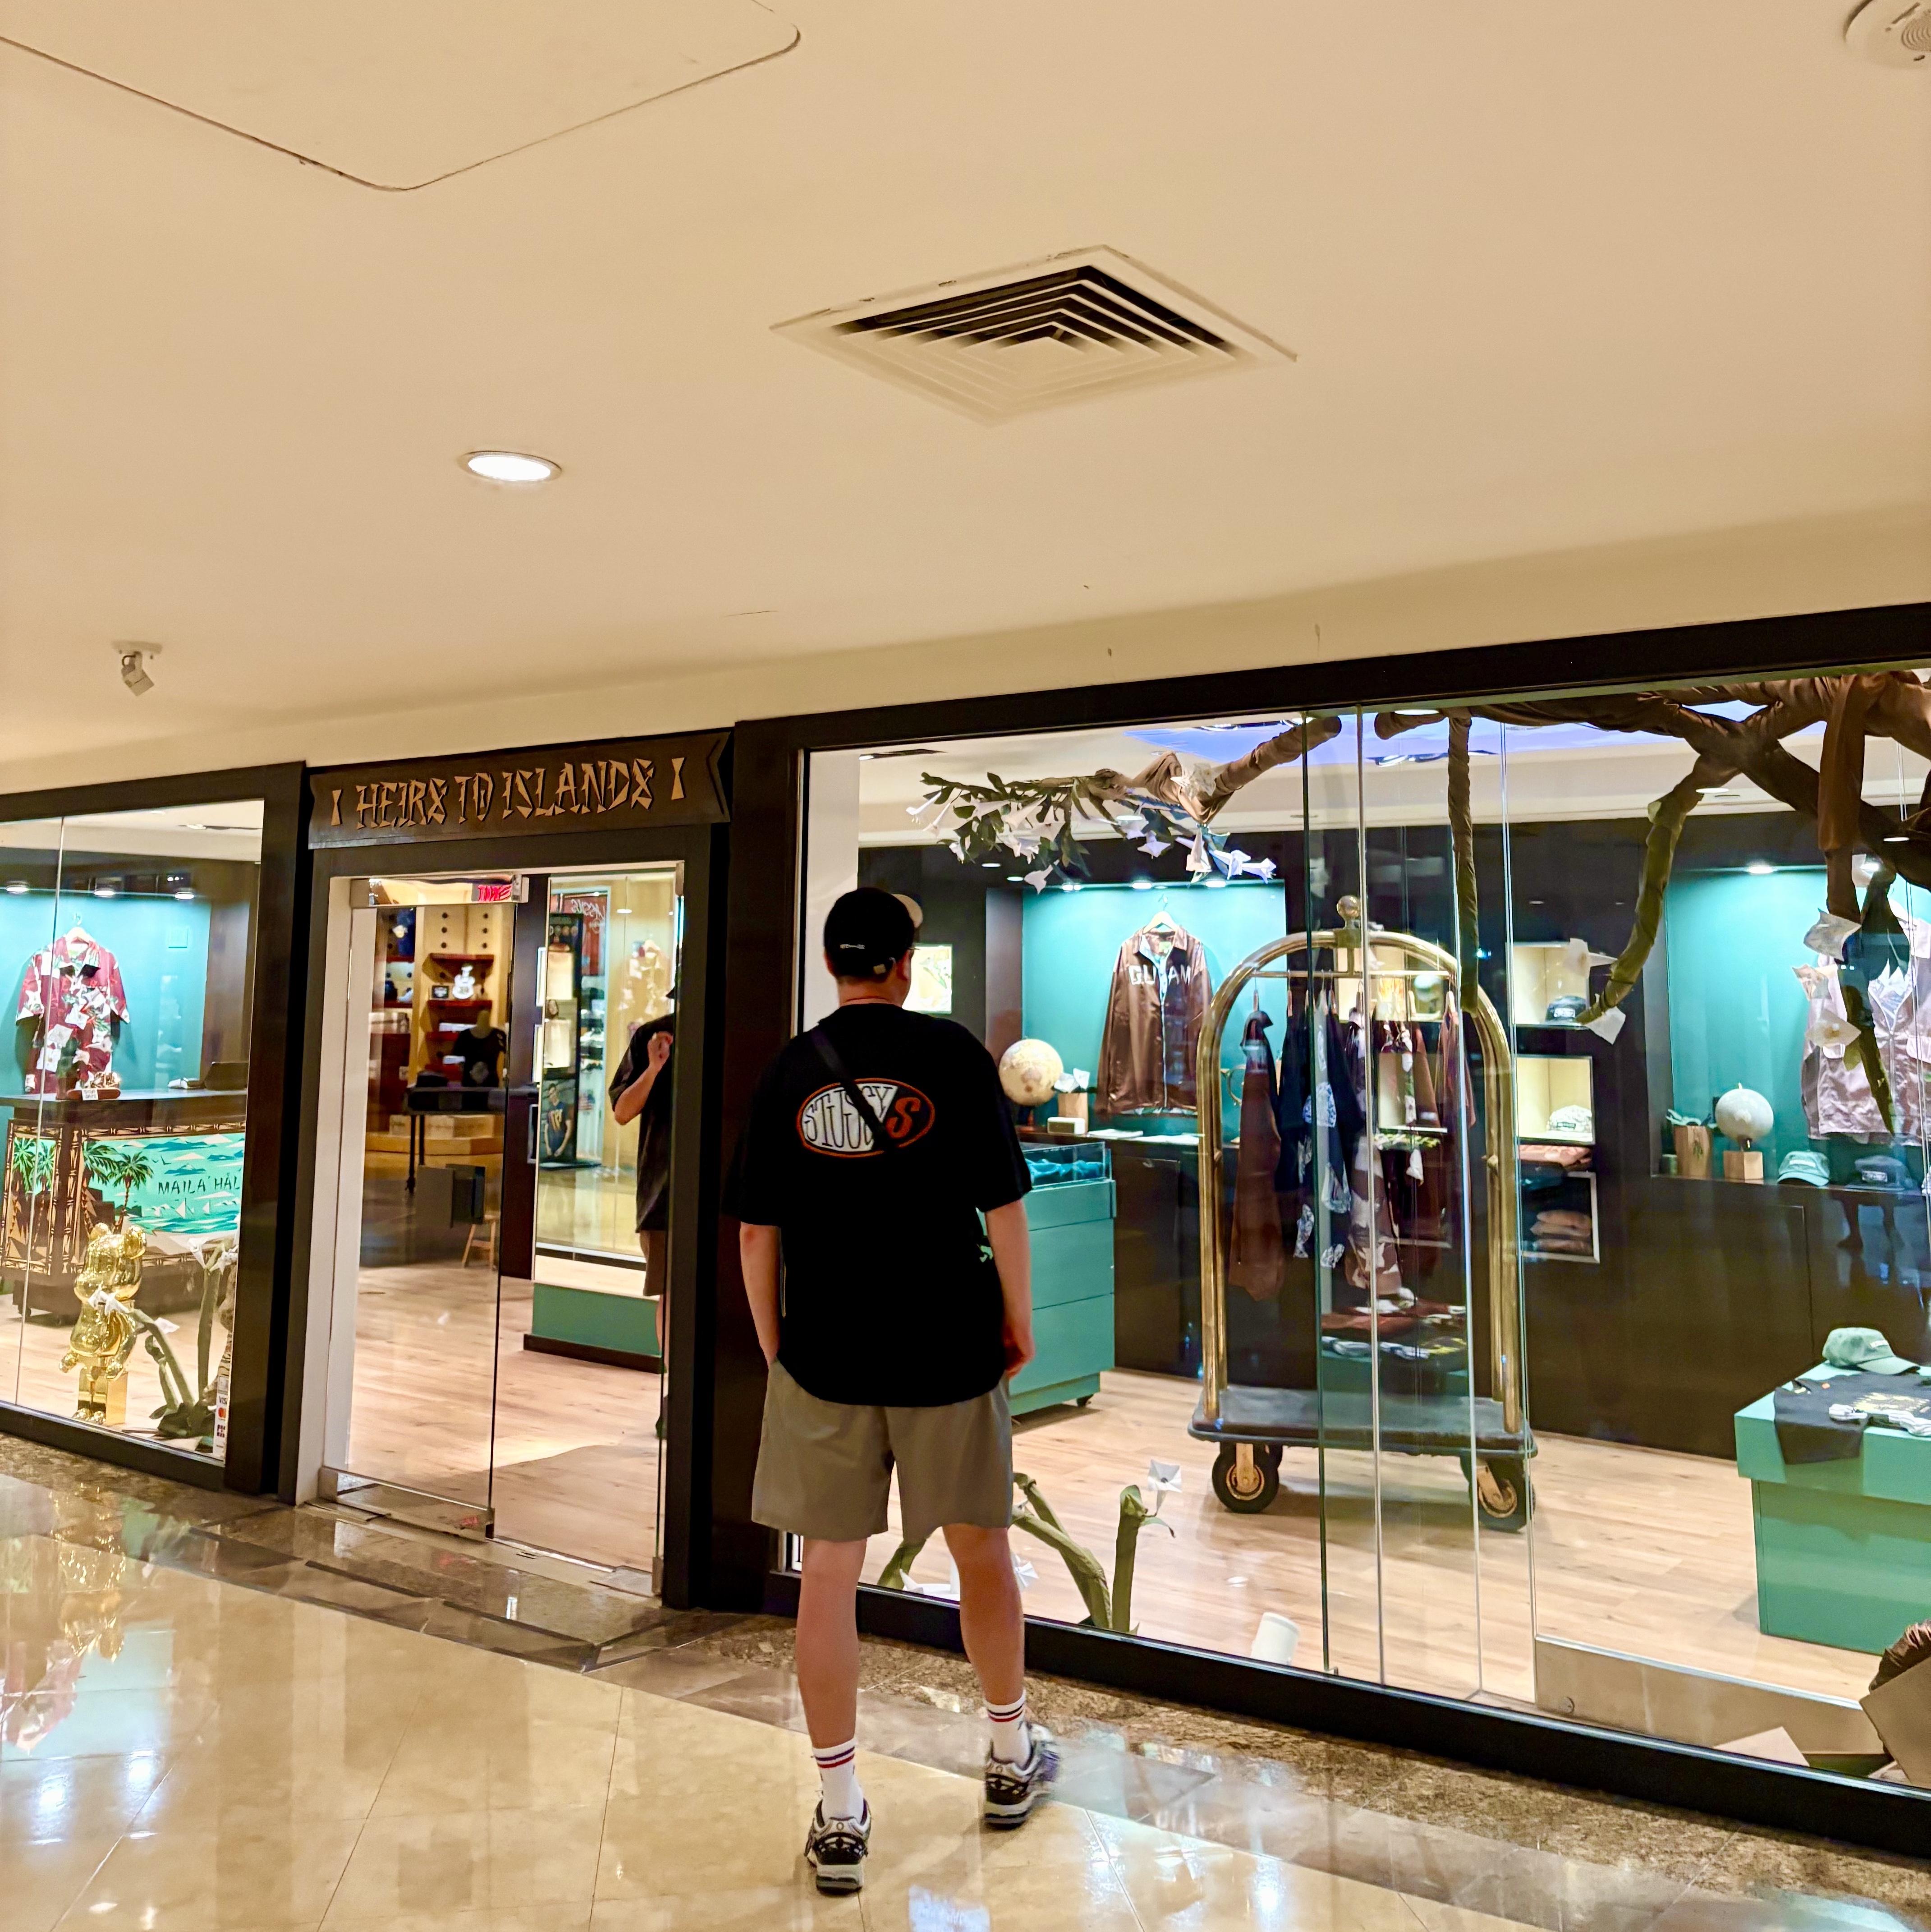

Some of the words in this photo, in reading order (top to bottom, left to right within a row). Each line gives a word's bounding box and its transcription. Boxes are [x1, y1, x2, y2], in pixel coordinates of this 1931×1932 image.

[356, 777, 448, 830] HEIRS
[454, 772, 495, 825] TO
[501, 758, 654, 819] ISLANDS
[1128, 964, 1191, 986] GUAM
